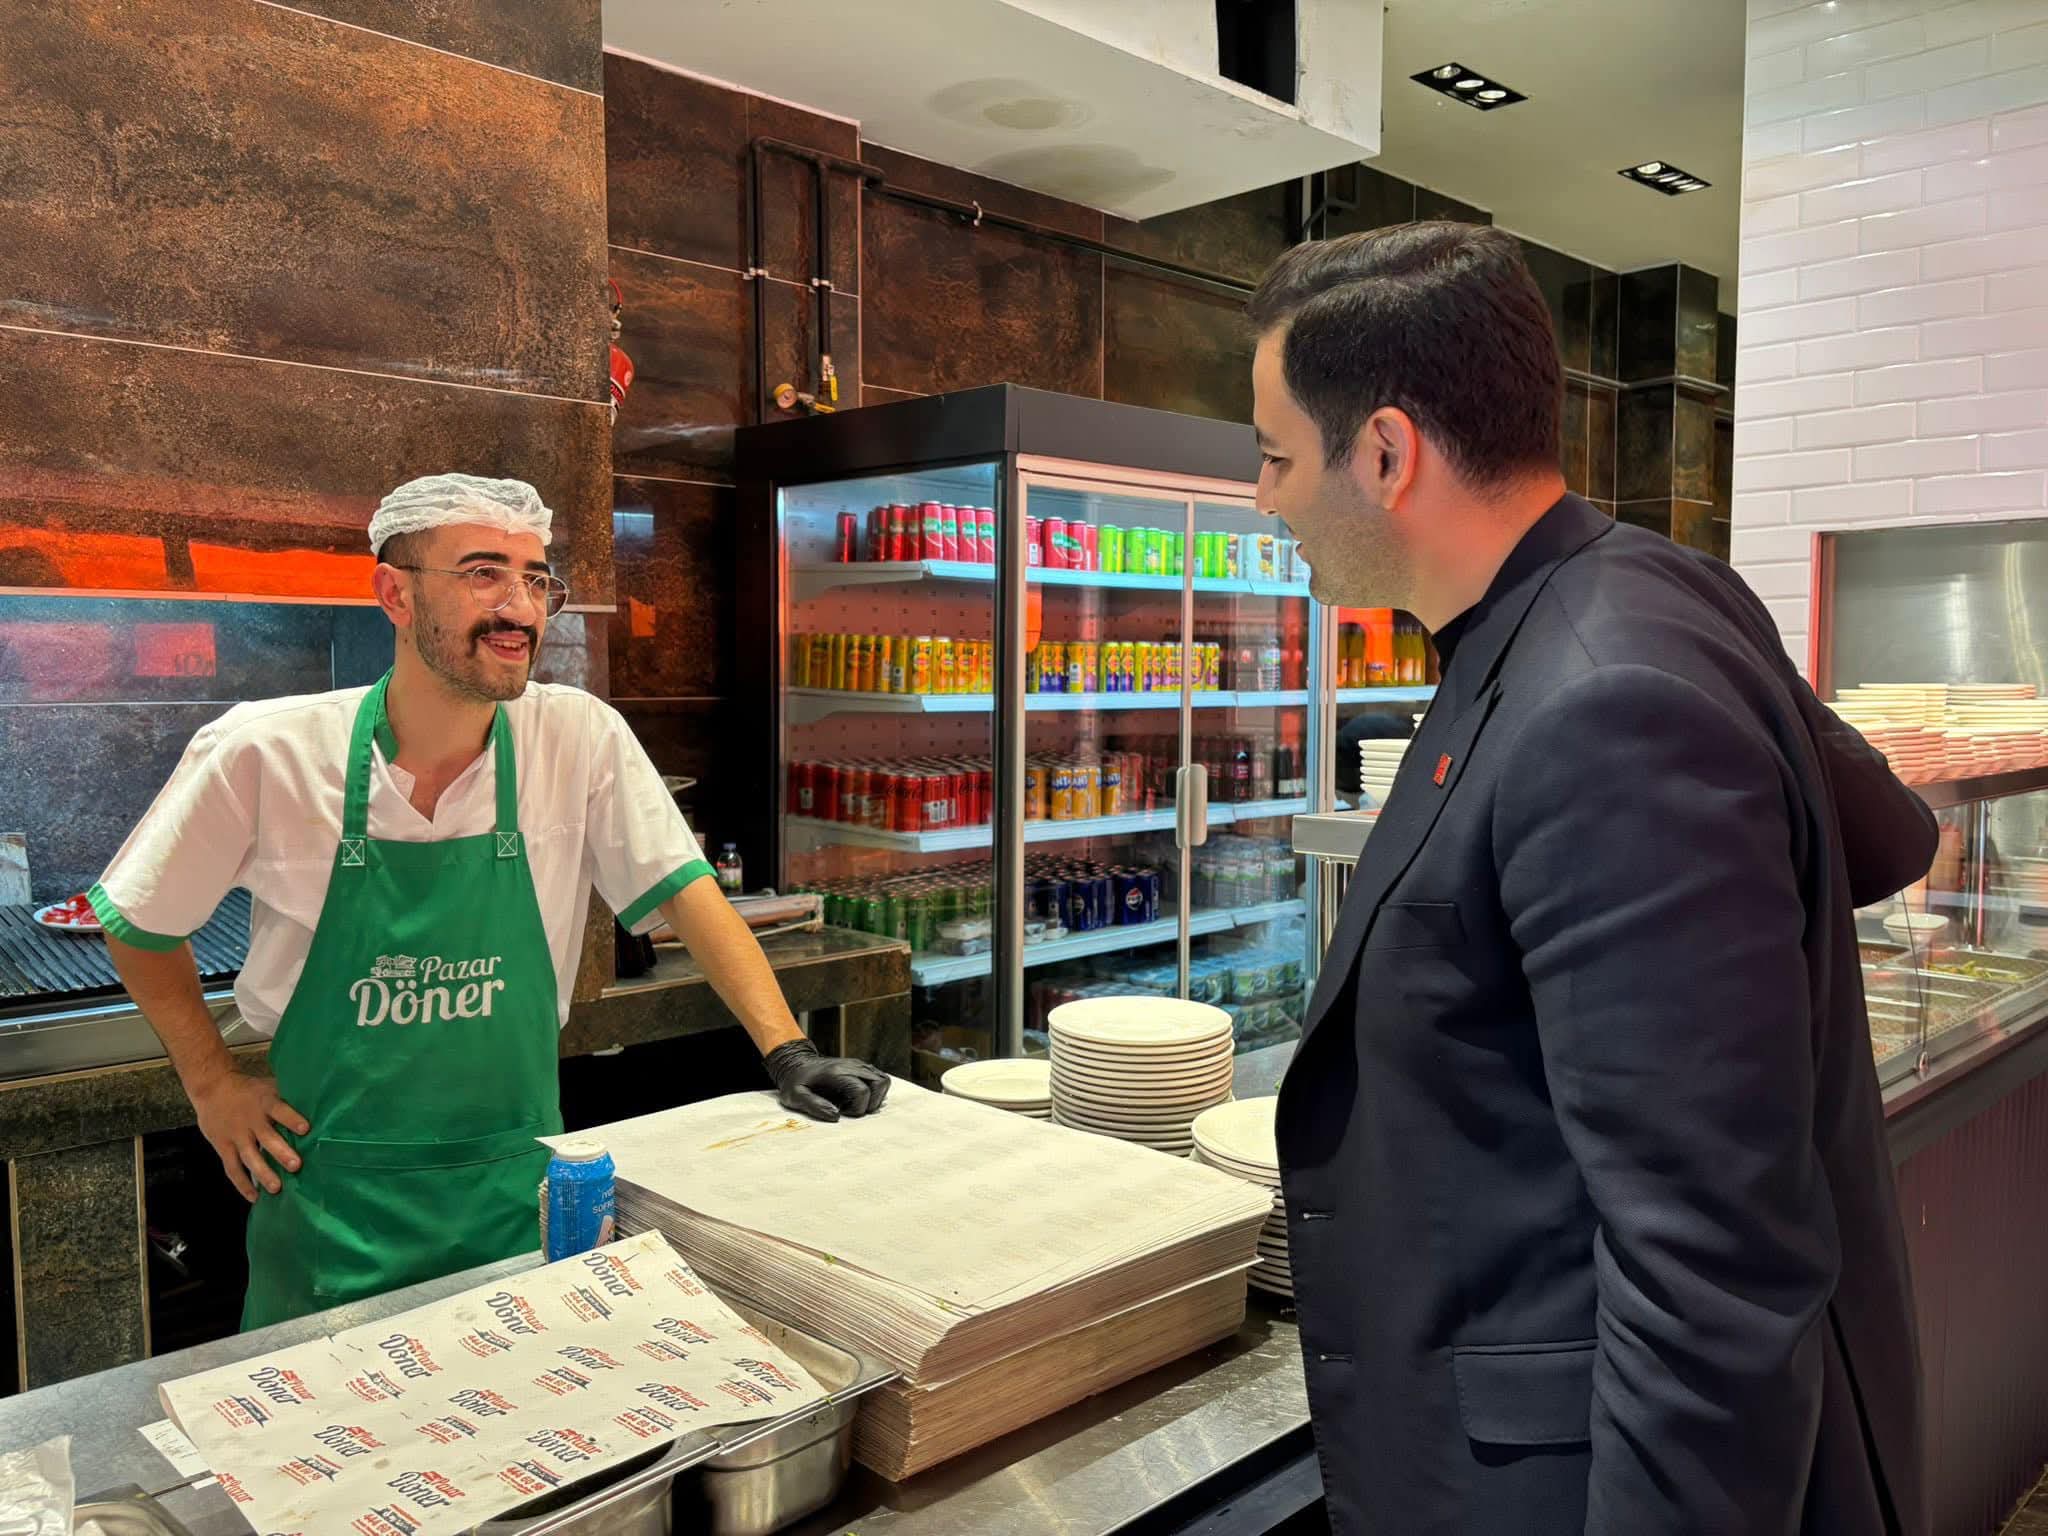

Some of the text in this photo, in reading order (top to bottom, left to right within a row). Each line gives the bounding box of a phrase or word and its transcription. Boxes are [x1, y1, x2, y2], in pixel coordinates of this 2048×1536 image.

[420, 956, 502, 984] Pazar
[349, 978, 505, 1026] Döner
[583, 1252, 634, 1297] Döner
[485, 1291, 539, 1335] Döner
[378, 1333, 432, 1379] Döner
[556, 1345, 614, 1369] Döner
[248, 1366, 301, 1405] Döner
[733, 1358, 793, 1392] Döner
[448, 1389, 507, 1417] Döner
[635, 1383, 699, 1411] Döner
[312, 1425, 372, 1457] Döner
[525, 1428, 591, 1462] Döner
[385, 1471, 451, 1508] Döner
